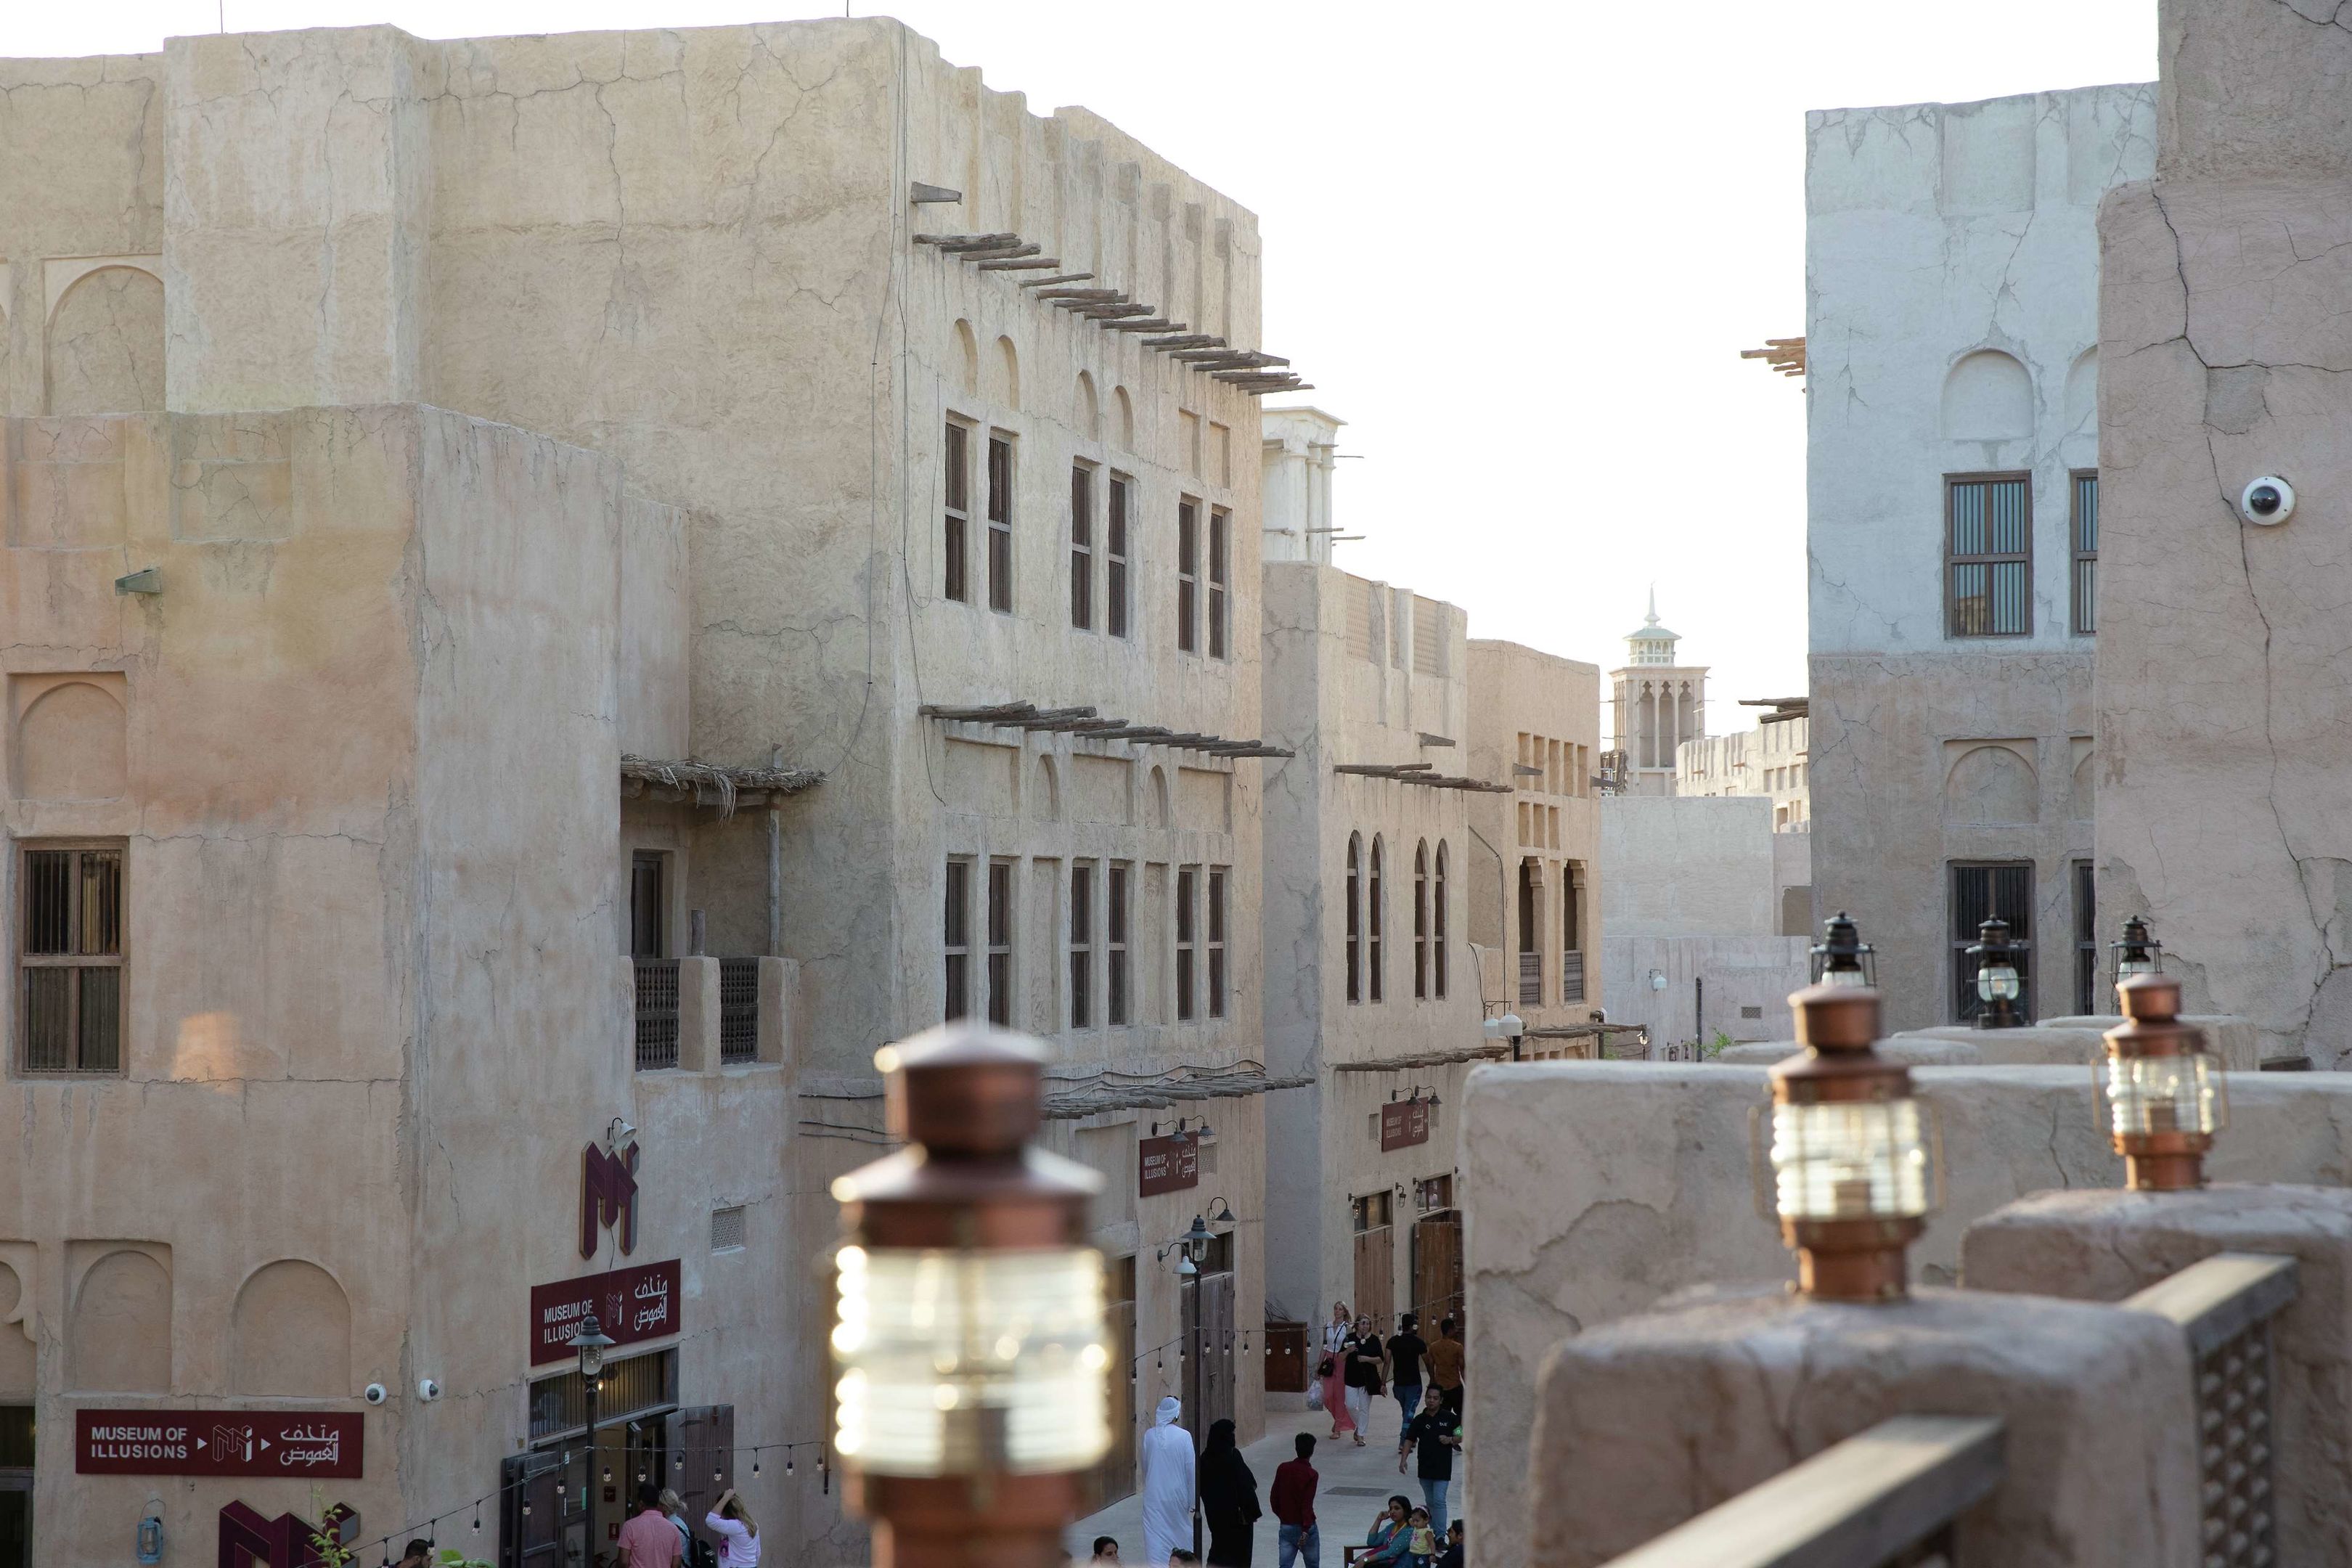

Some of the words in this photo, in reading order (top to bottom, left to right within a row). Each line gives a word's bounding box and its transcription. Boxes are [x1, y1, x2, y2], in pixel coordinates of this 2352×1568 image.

[1145, 1154, 1161, 1167] MUSEUM
[1161, 1153, 1167, 1164] OF
[1145, 1167, 1167, 1180] ILLUSIONS
[634, 1274, 668, 1299] متحف
[544, 1302, 579, 1324] MUSEUM
[581, 1299, 593, 1316] OF
[544, 1321, 583, 1344] ILLUSIO
[91, 1426, 162, 1441] MUSEUM
[166, 1427, 187, 1441] OF
[280, 1424, 339, 1441] متحف
[91, 1445, 187, 1458] ILLUSIONS
[280, 1442, 339, 1467] الغموض
